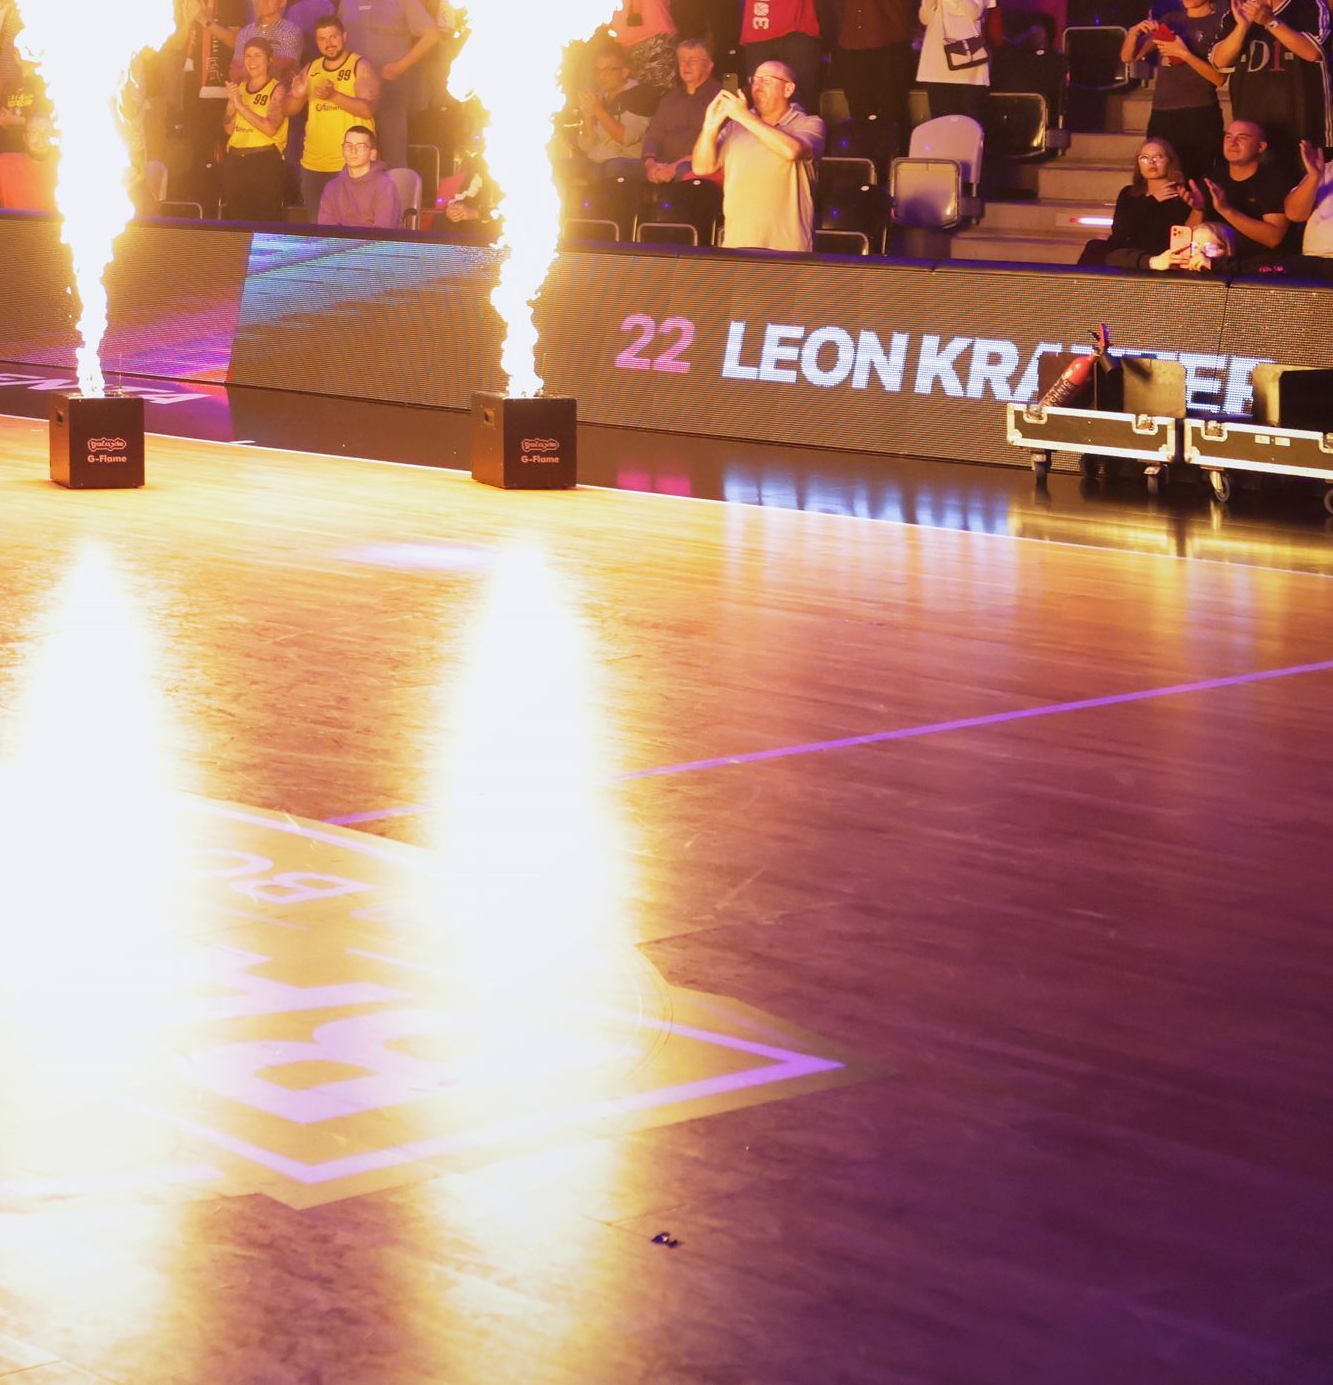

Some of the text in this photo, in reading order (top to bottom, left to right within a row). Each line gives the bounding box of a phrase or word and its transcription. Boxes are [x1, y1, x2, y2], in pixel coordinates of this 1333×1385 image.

[337, 68, 352, 82] 99
[253, 93, 268, 106] 99
[614, 313, 696, 372] 22
[721, 319, 908, 392] LEON
[87, 454, 127, 464] G-Flame
[520, 454, 560, 464] G-Flame
